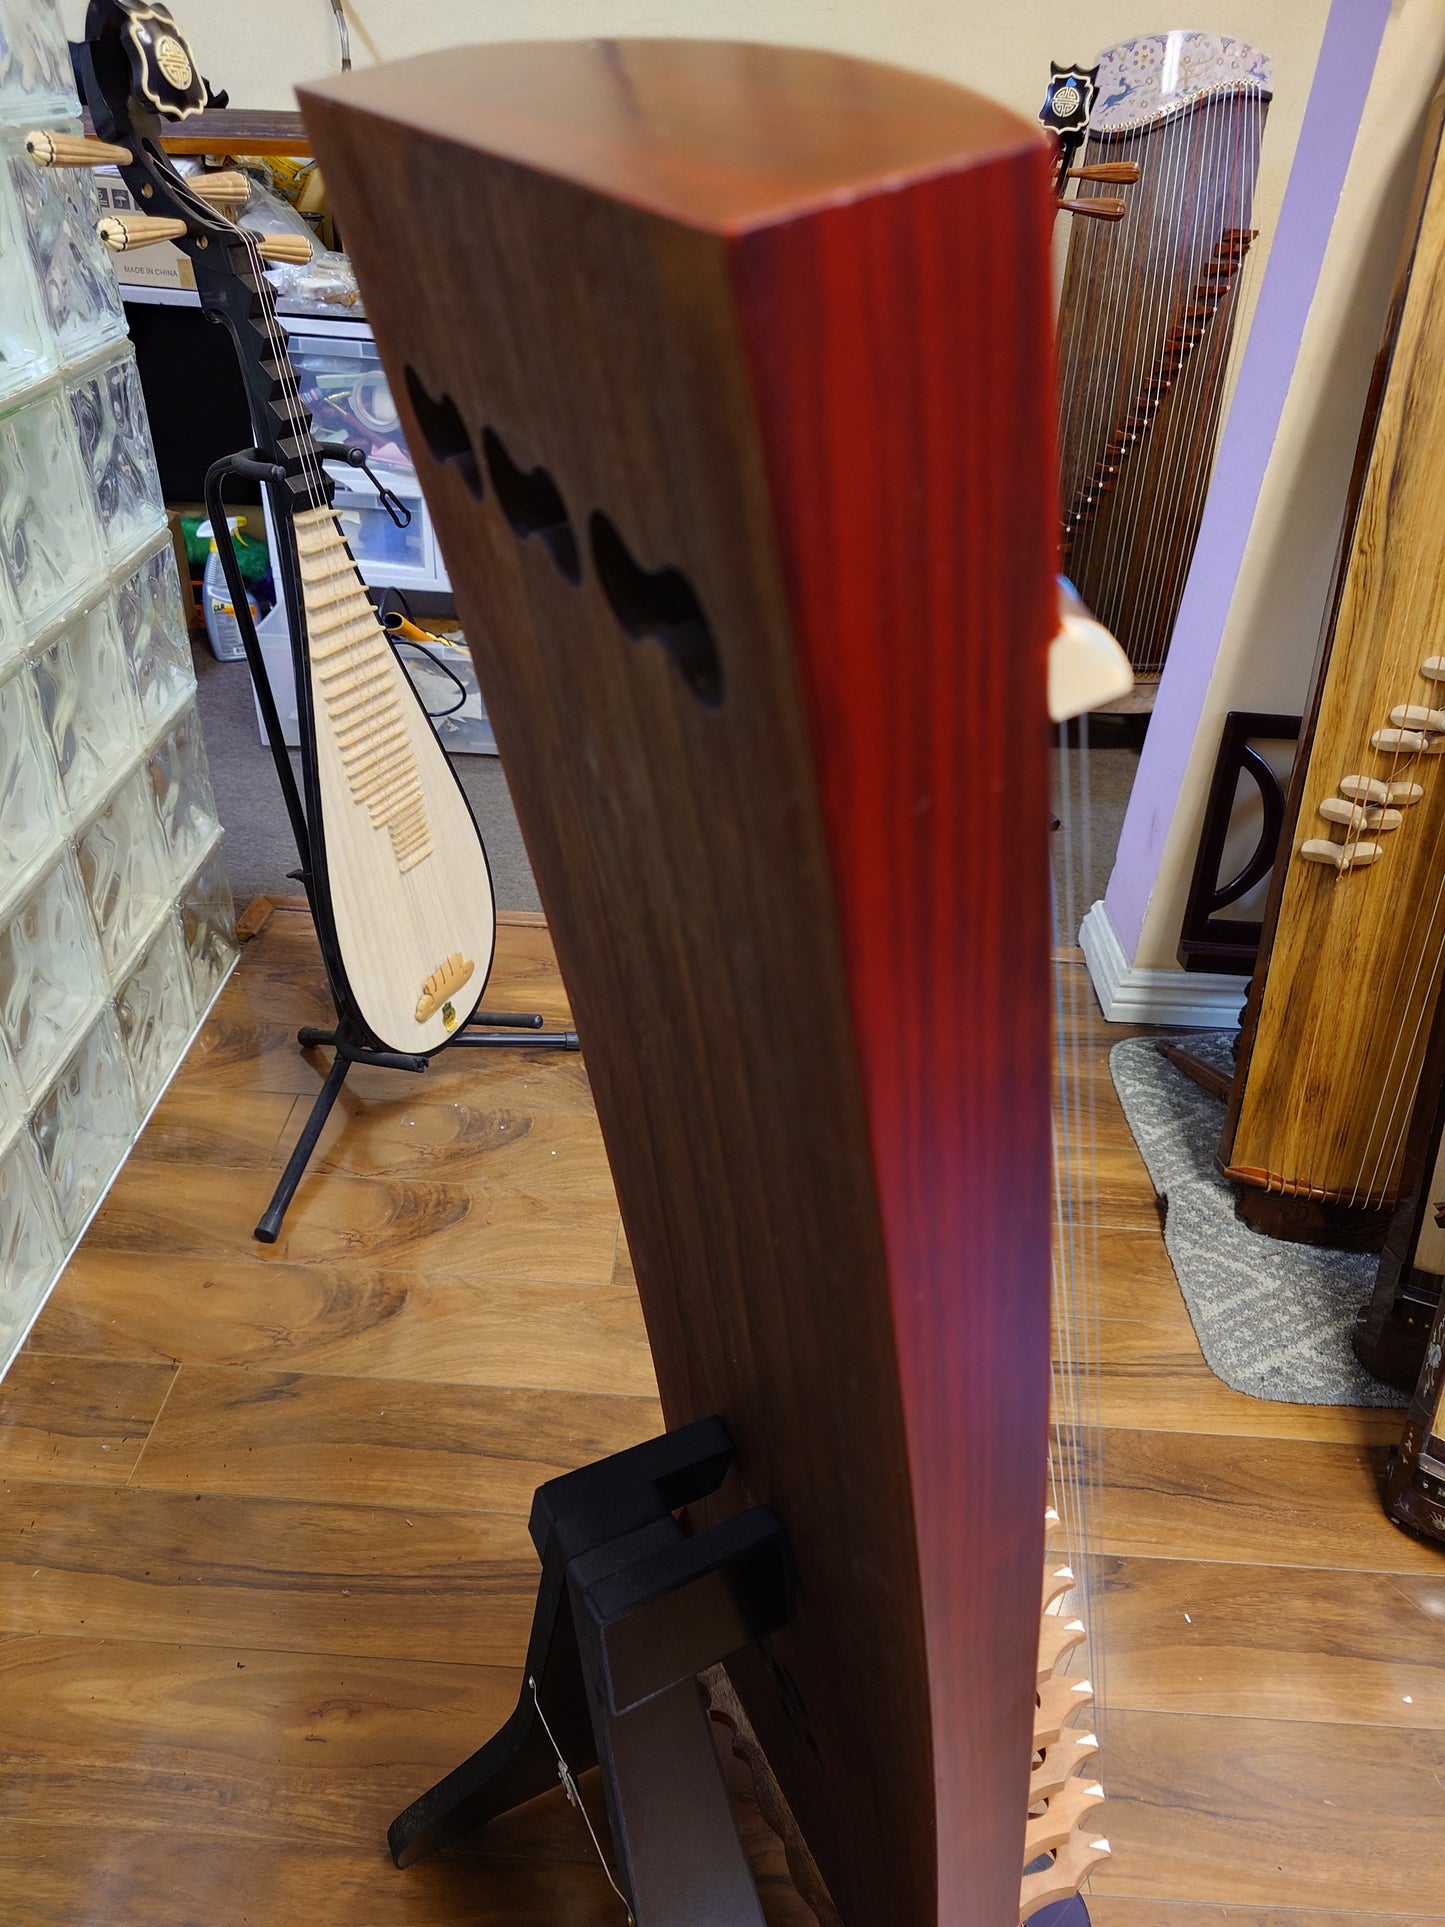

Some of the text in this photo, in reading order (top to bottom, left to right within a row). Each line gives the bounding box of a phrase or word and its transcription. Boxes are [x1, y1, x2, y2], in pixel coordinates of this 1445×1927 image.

[124, 265, 178, 277] MADE IN CHINA
